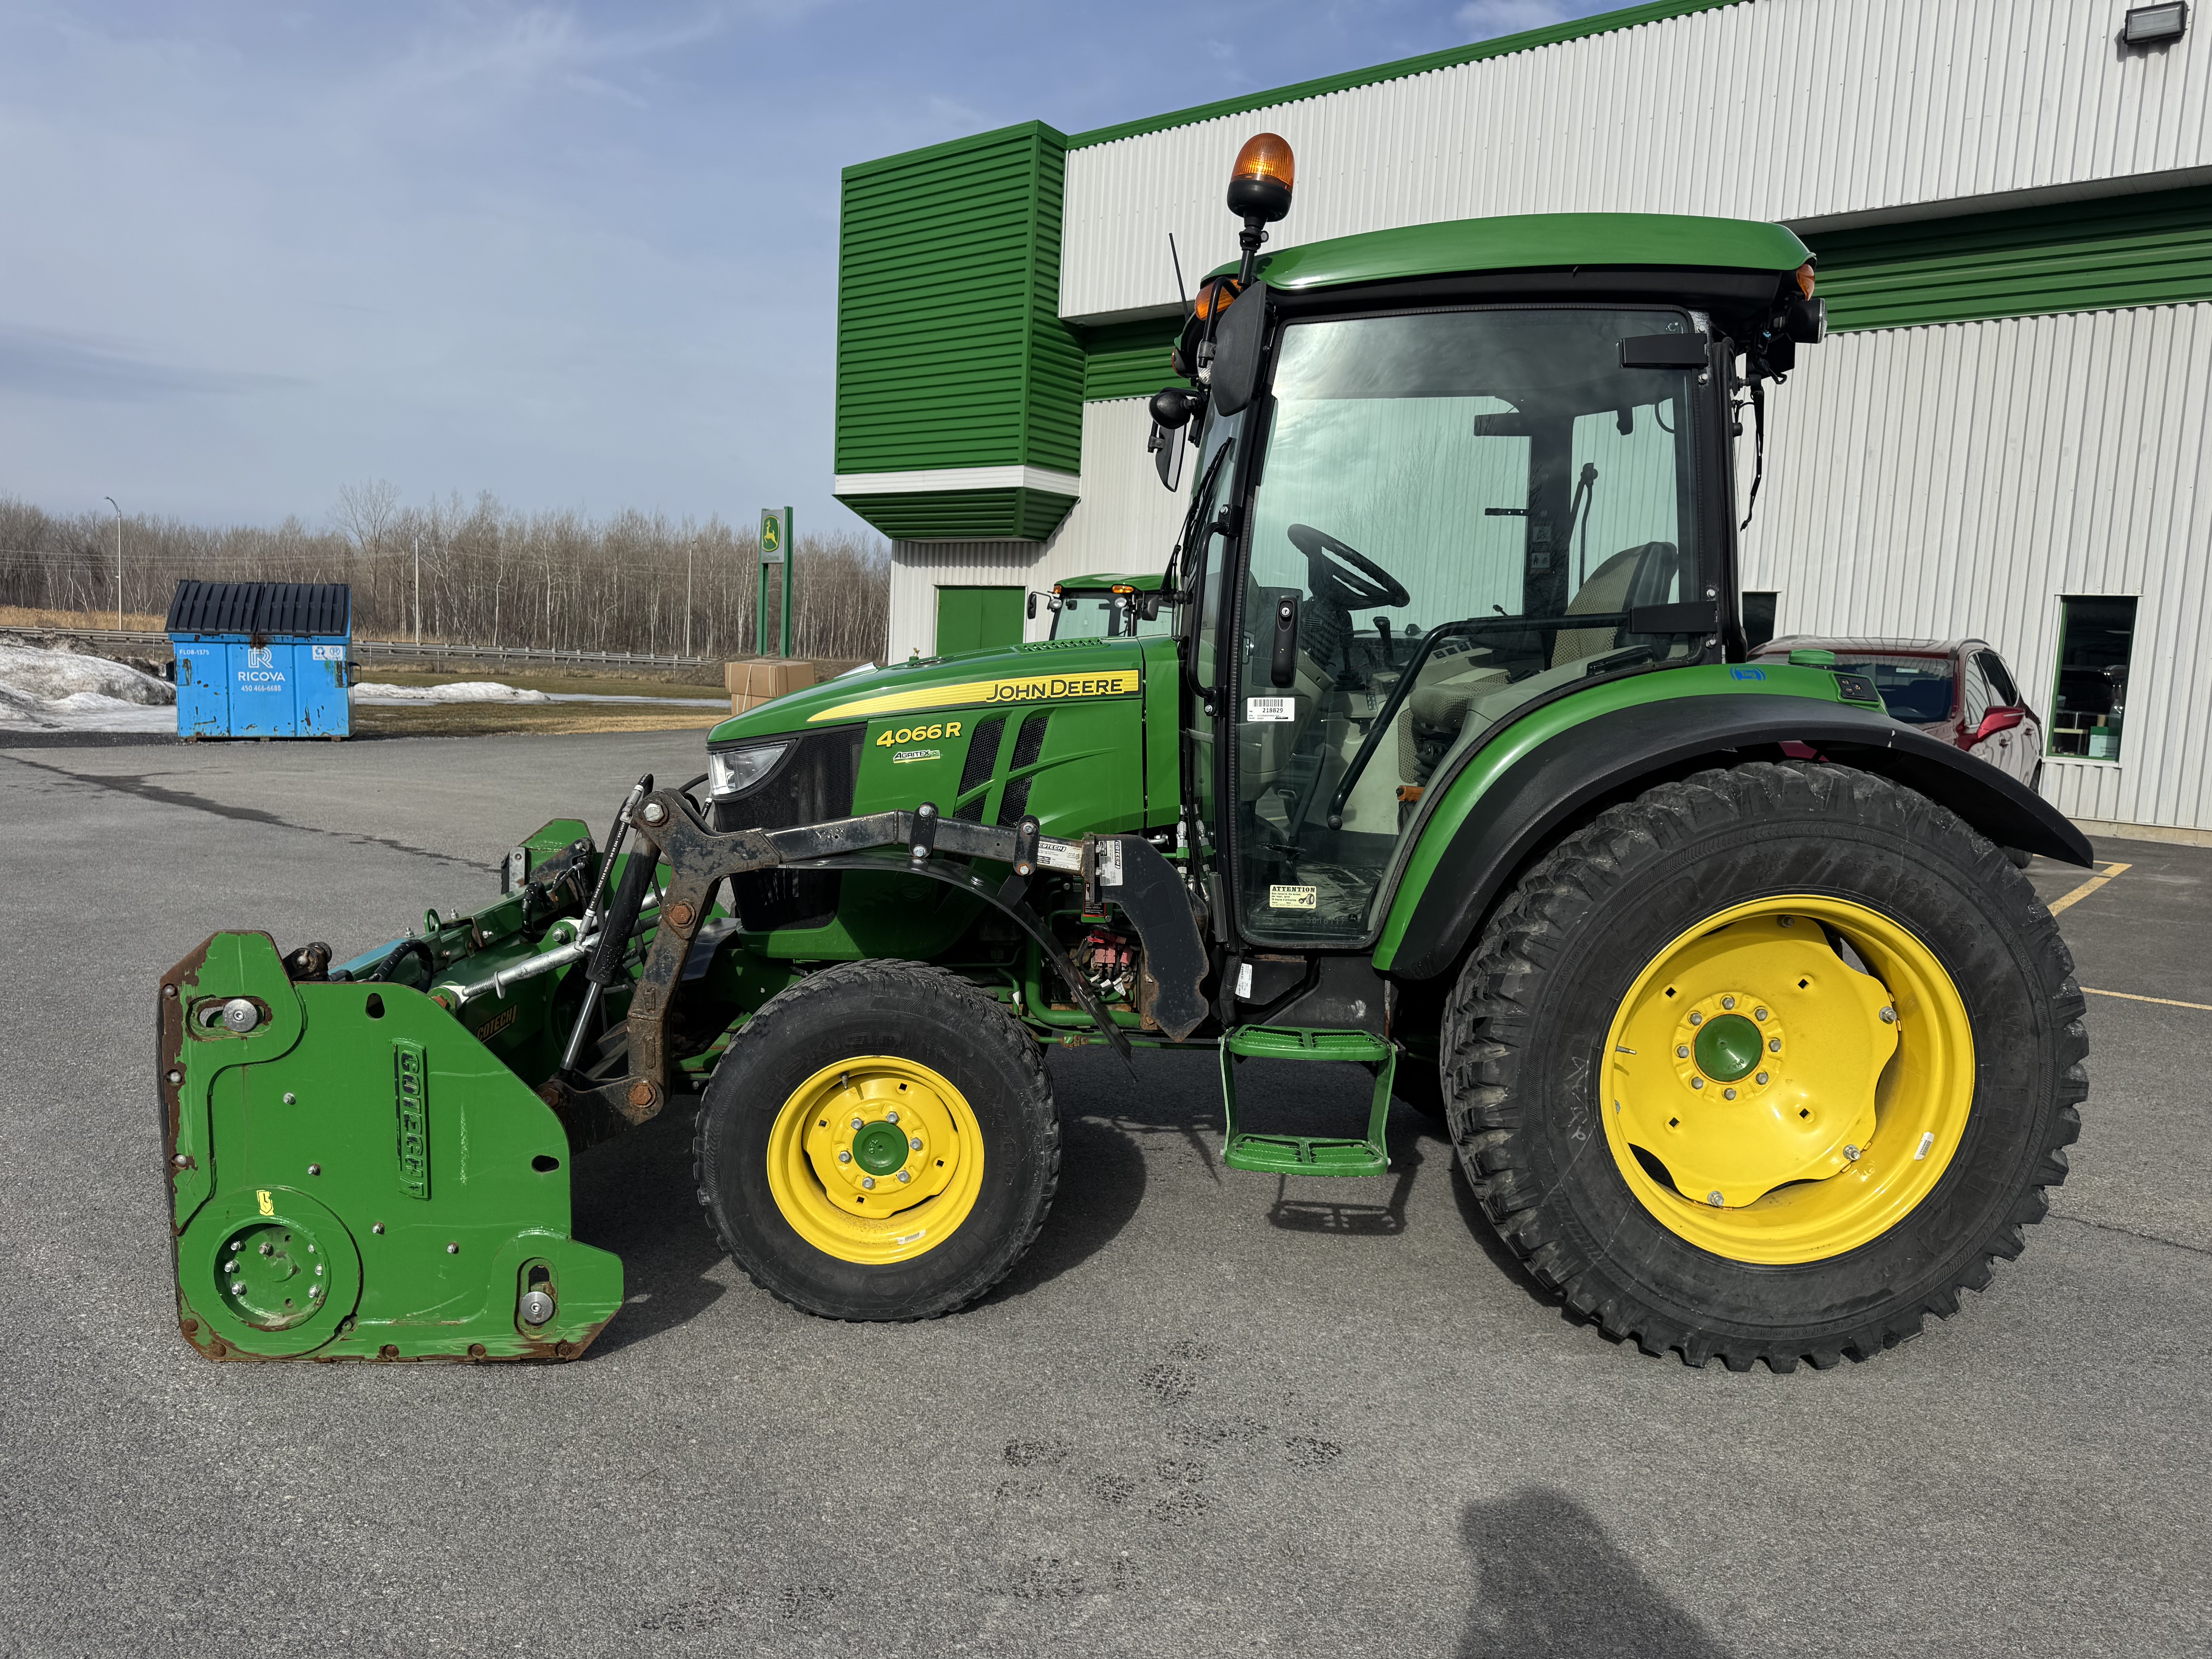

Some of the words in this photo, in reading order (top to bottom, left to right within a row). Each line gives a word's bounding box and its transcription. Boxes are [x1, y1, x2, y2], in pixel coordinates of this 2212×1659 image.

[238, 672, 285, 682] RICOVA
[987, 683, 1046, 700] JOHN
[1051, 678, 1123, 697] DEERE
[477, 1007, 512, 1041] COTECH
[401, 1050, 424, 1178] COTECH
